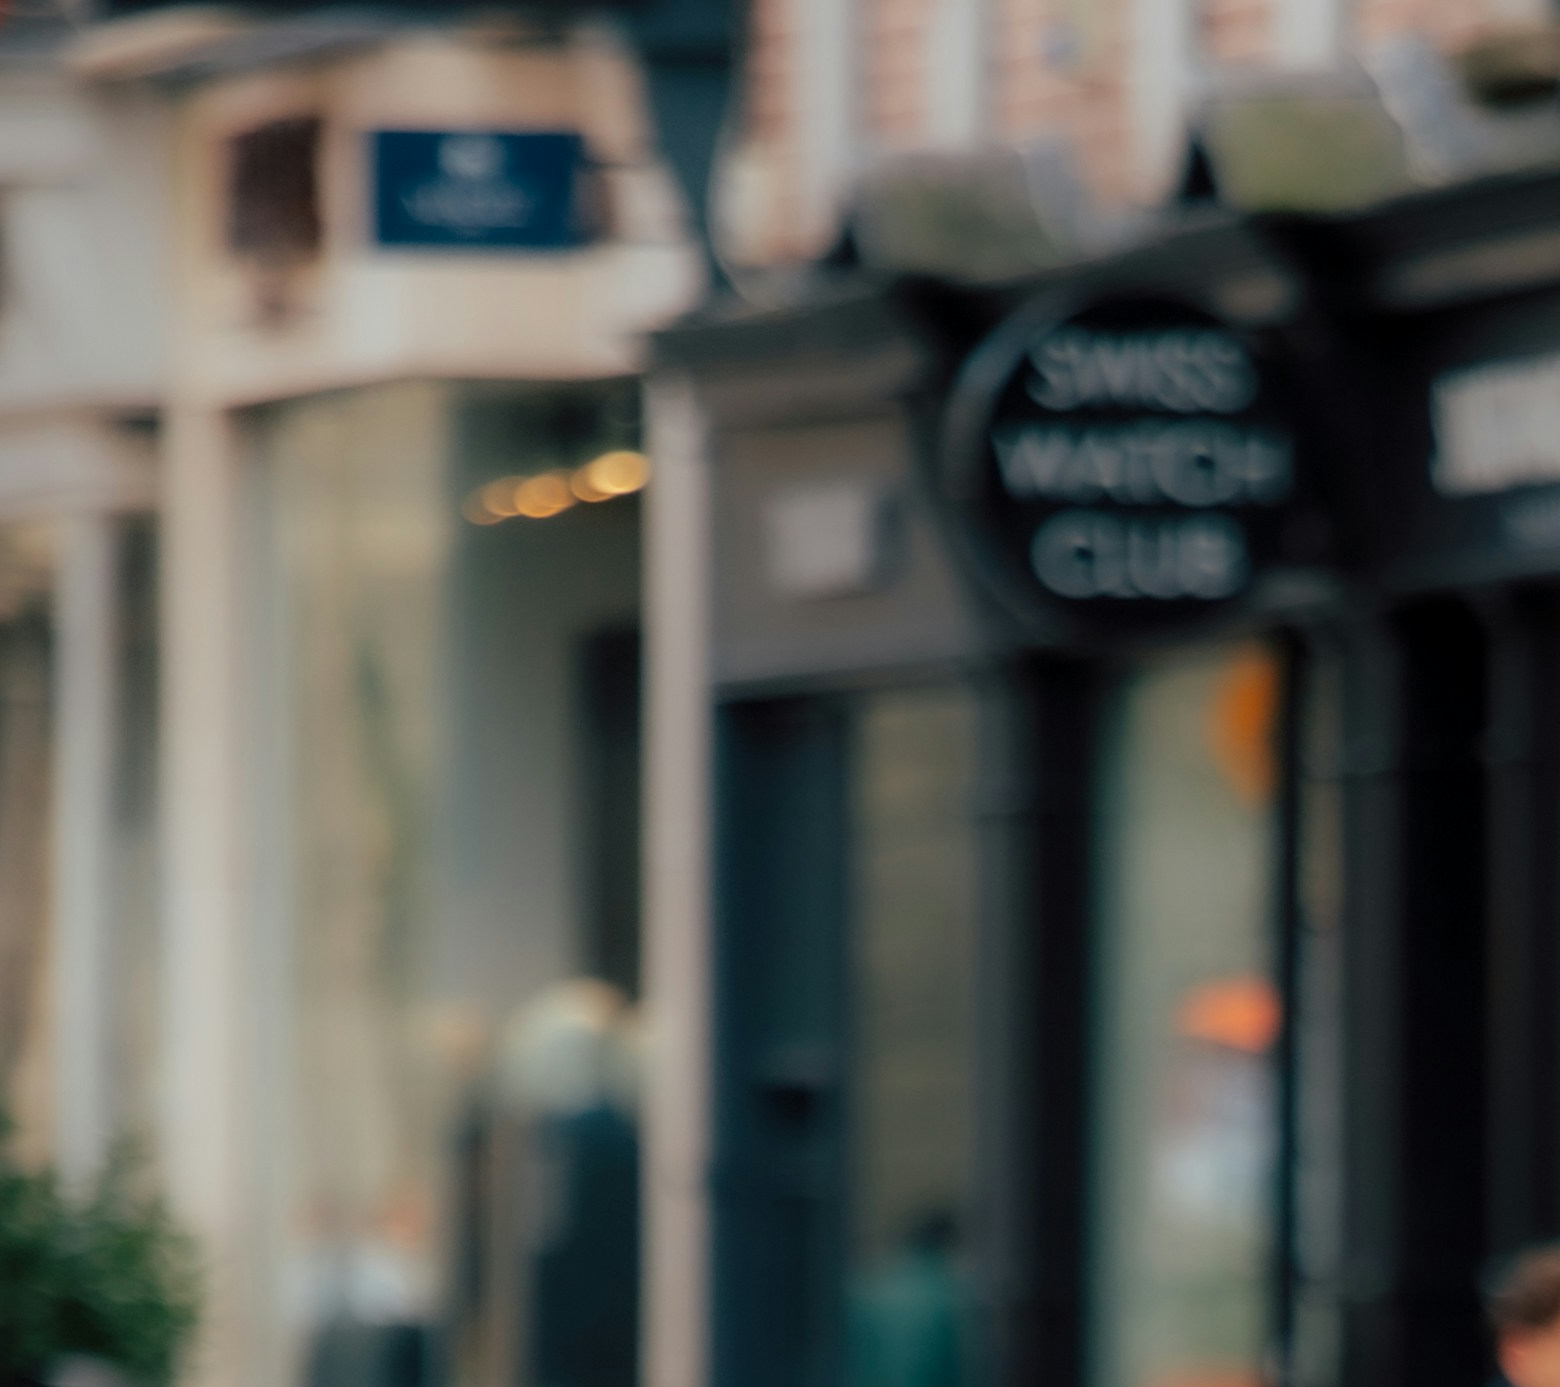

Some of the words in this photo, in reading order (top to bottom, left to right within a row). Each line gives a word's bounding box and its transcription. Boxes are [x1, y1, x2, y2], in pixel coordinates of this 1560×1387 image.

[1026, 322, 1258, 413] SWISS
[990, 417, 1296, 507] WATCH
[1028, 507, 1252, 600] CLUB
